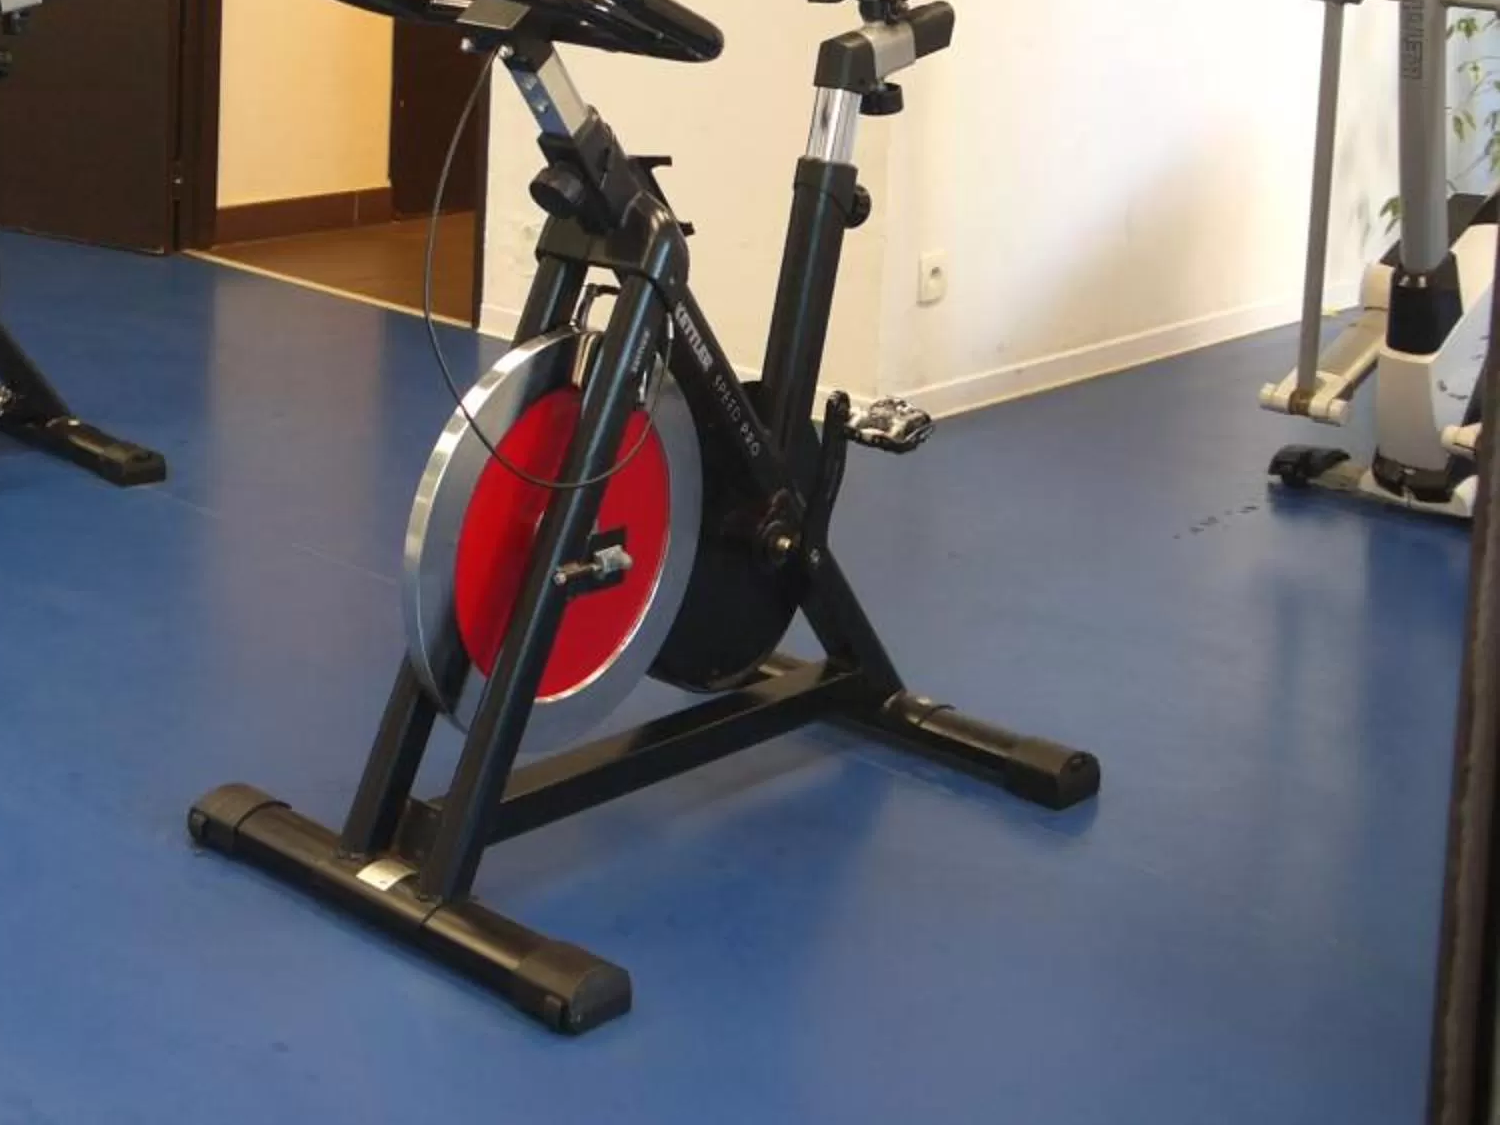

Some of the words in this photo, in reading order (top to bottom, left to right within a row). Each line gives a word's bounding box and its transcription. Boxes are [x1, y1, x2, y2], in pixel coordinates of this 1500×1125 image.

[675, 302, 714, 372] KETTLER
[715, 375, 741, 422] SPEED
[739, 422, 760, 456] PRO
